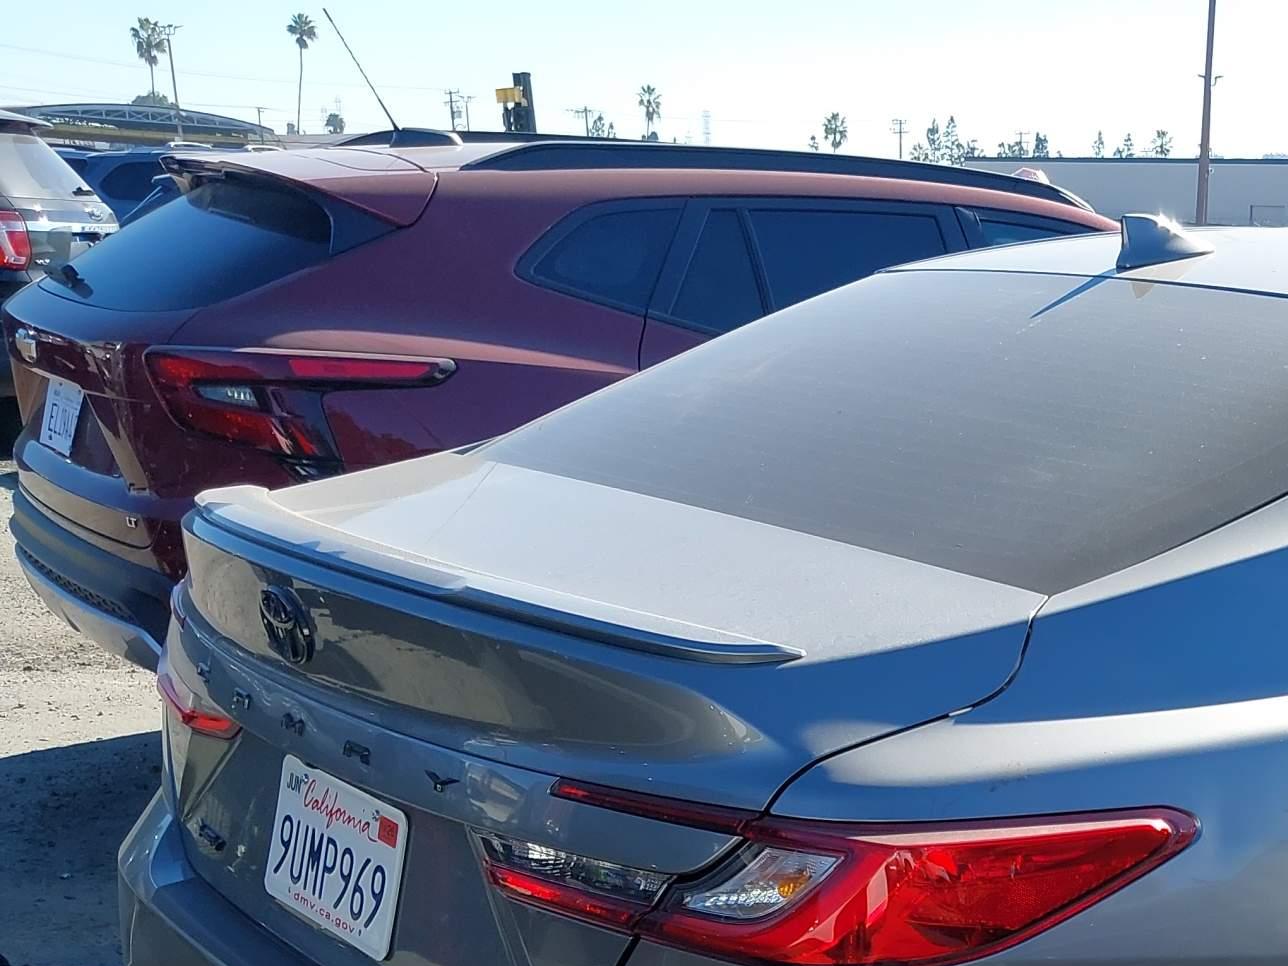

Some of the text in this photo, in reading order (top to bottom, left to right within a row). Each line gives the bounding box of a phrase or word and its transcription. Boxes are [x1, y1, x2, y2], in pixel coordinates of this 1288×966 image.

[286, 772, 304, 796] JUN
[304, 779, 378, 842] California
[273, 814, 386, 929] 9UMP969
[293, 893, 356, 933] dmv.ca.gov
